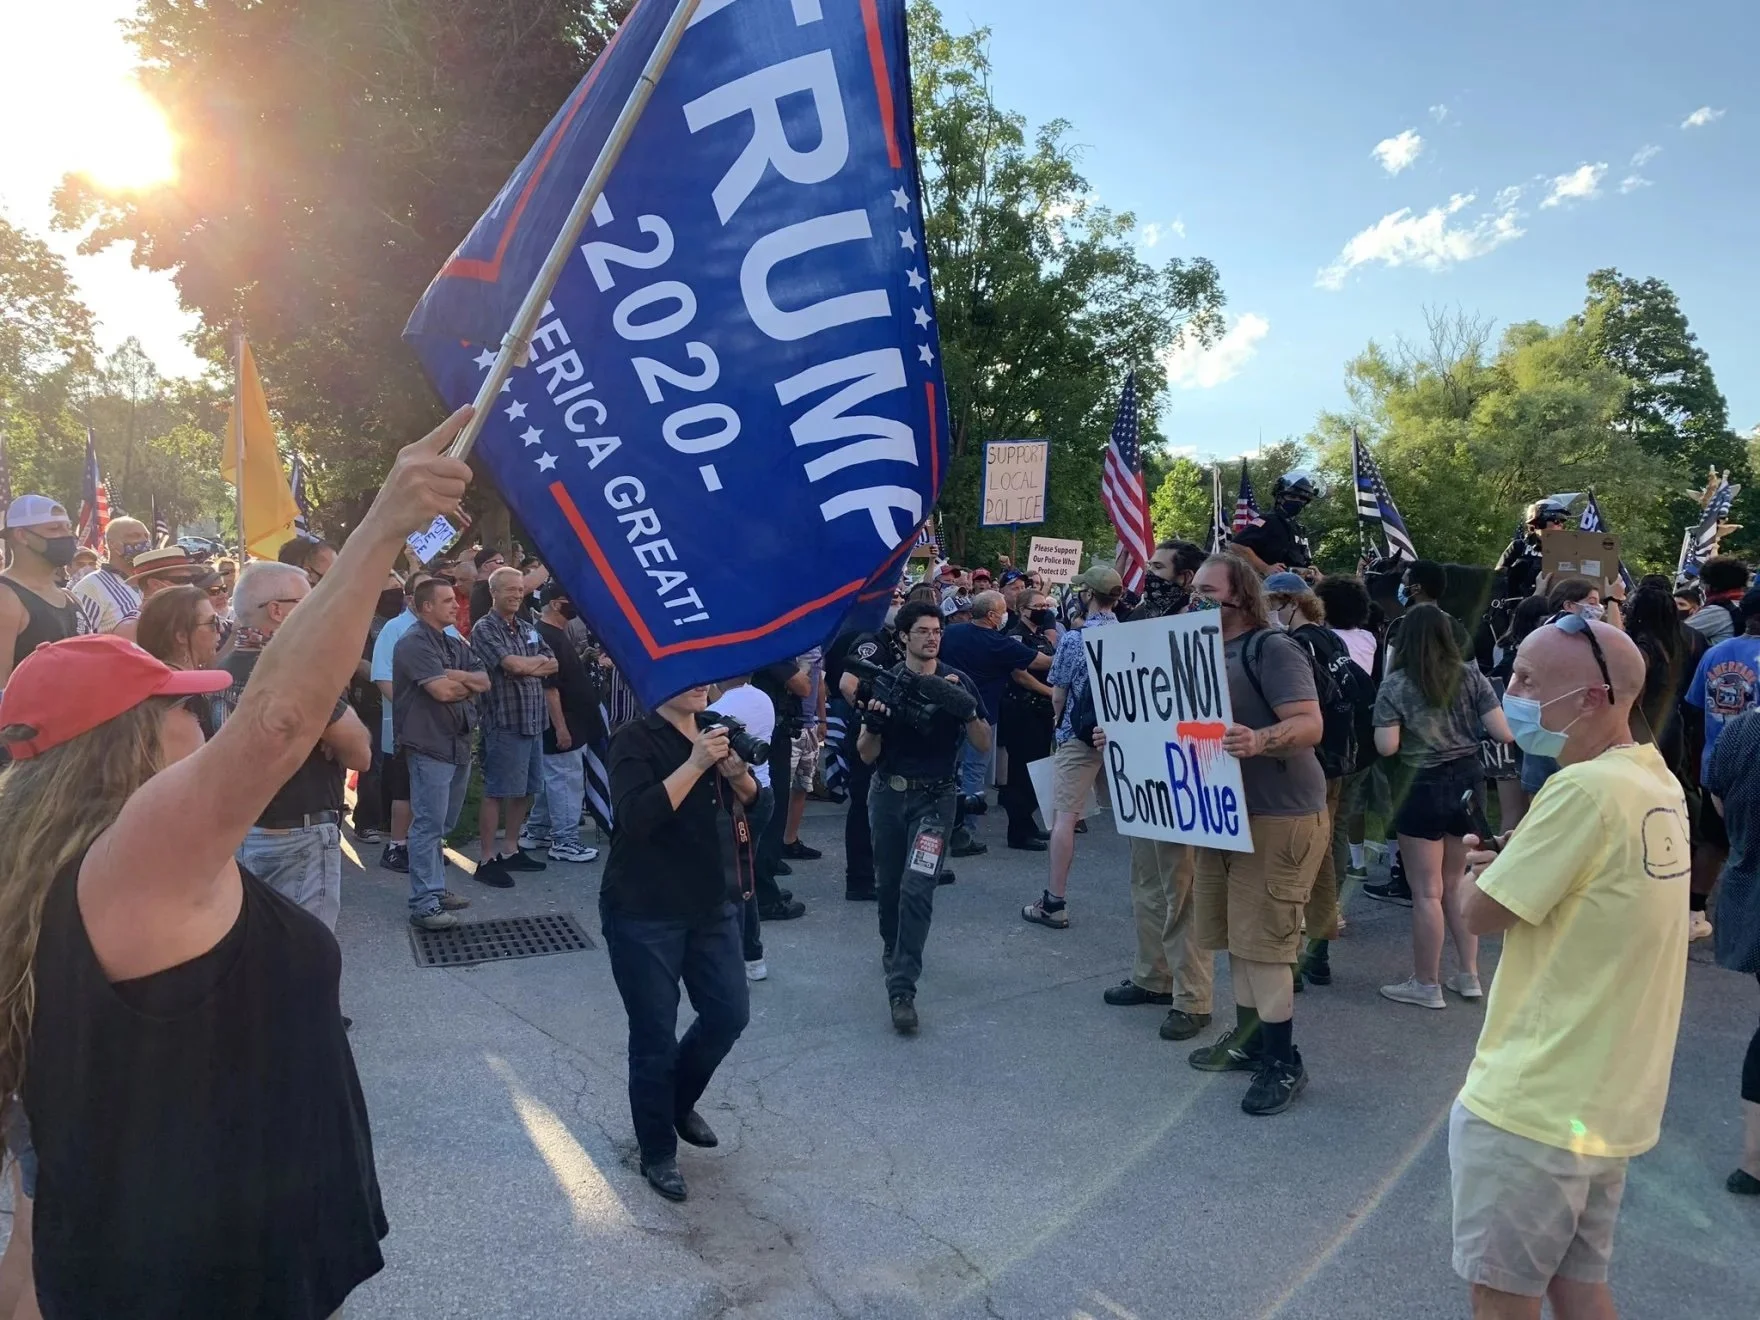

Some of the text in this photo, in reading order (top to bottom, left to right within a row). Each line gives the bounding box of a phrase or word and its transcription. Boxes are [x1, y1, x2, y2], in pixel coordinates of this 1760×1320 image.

[988, 444, 1046, 465] SUPPORT
[989, 471, 1038, 491] LOCAL
[985, 495, 1043, 522] POLICE
[603, 475, 710, 626] GREAT!
[1034, 543, 1078, 556] Please Support
[1032, 555, 1076, 566] Our Police Who
[1037, 566, 1059, 576] Protect
[1085, 625, 1223, 723] You're NOT
[1109, 740, 1239, 837] Born Blue
[738, 821, 748, 843] EOS
